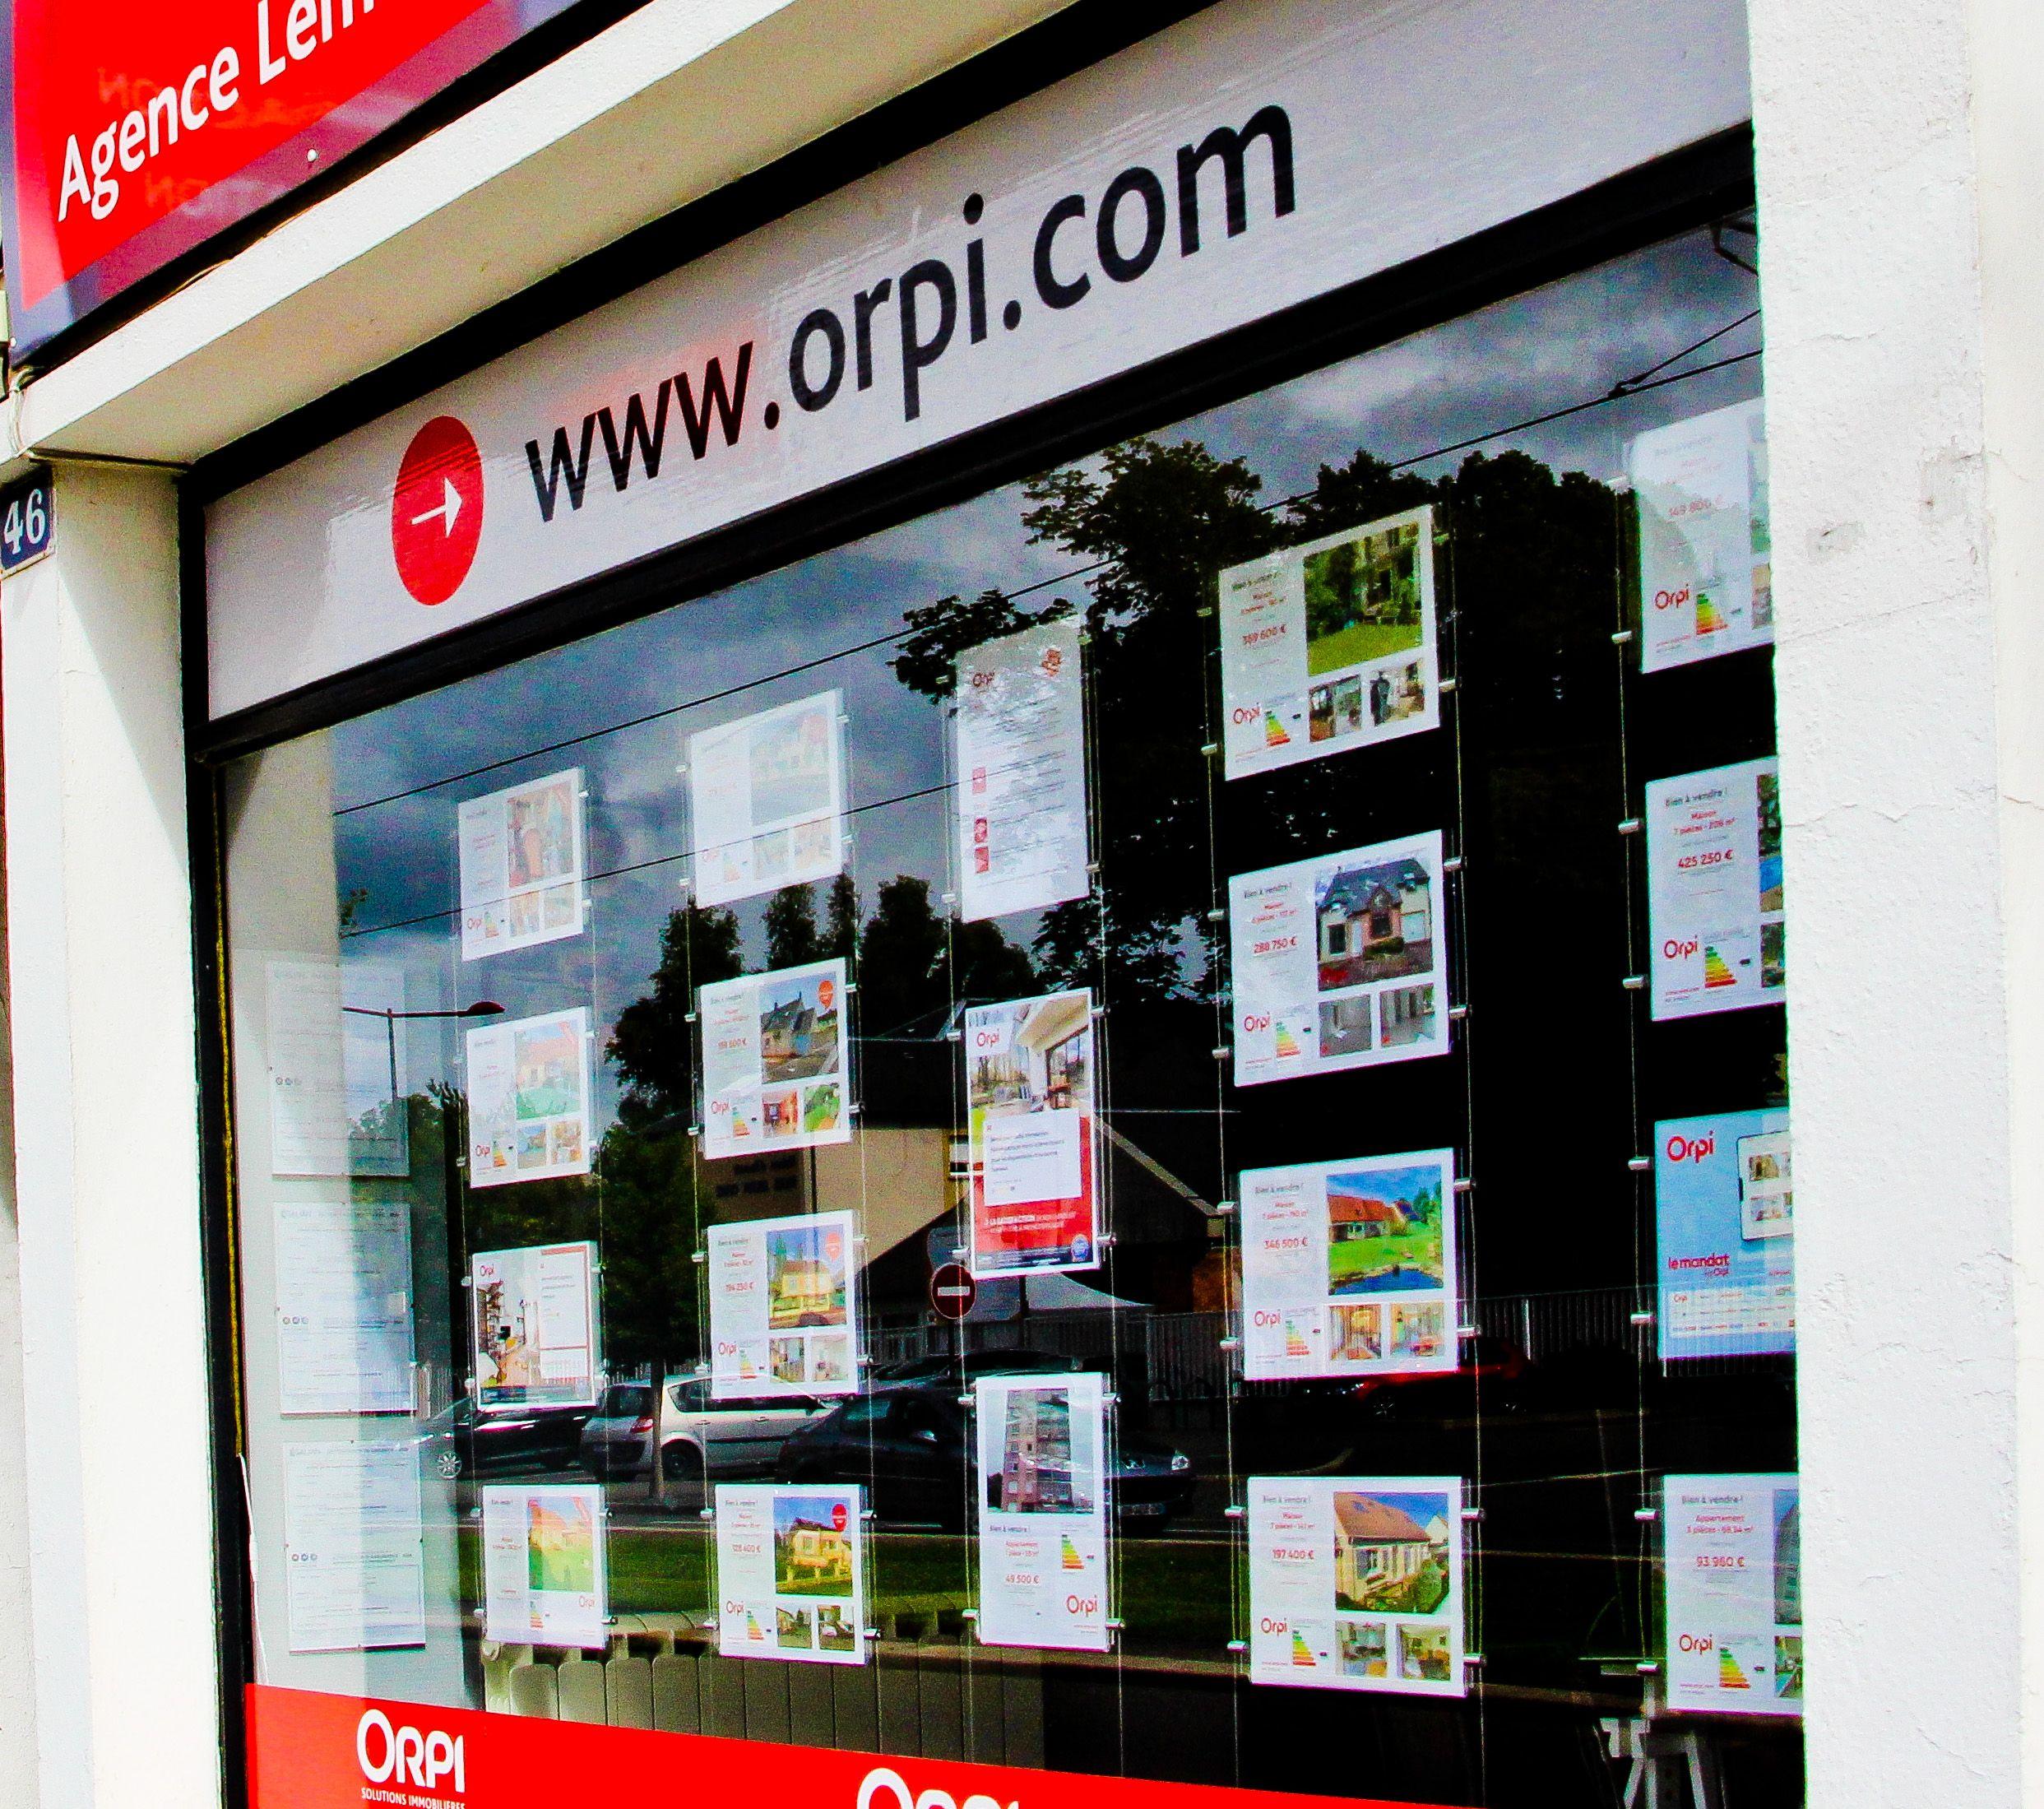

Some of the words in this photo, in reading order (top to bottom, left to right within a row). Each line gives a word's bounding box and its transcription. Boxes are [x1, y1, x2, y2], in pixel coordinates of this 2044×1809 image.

[58, 46, 239, 221] Agence
[525, 104, 1295, 522] www.orpi.com
[2, 489, 47, 554] 46
[1655, 584, 1689, 610] Orpi
[1678, 856, 1698, 868] 425
[1700, 852, 1722, 865] 250
[1663, 935, 1699, 960] Orpi
[1244, 1011, 1271, 1034] Orpi
[1666, 1130, 1715, 1163] Orpi
[1253, 1310, 1281, 1327] Orpi
[718, 1341, 737, 1357] Orpi
[1066, 1594, 1098, 1617] Orpi
[1261, 1617, 1288, 1636] Orpi
[1679, 1634, 1713, 1656] Orpi
[356, 1709, 466, 1793] ORPI
[361, 1788, 407, 1806] SOLUTIONS
